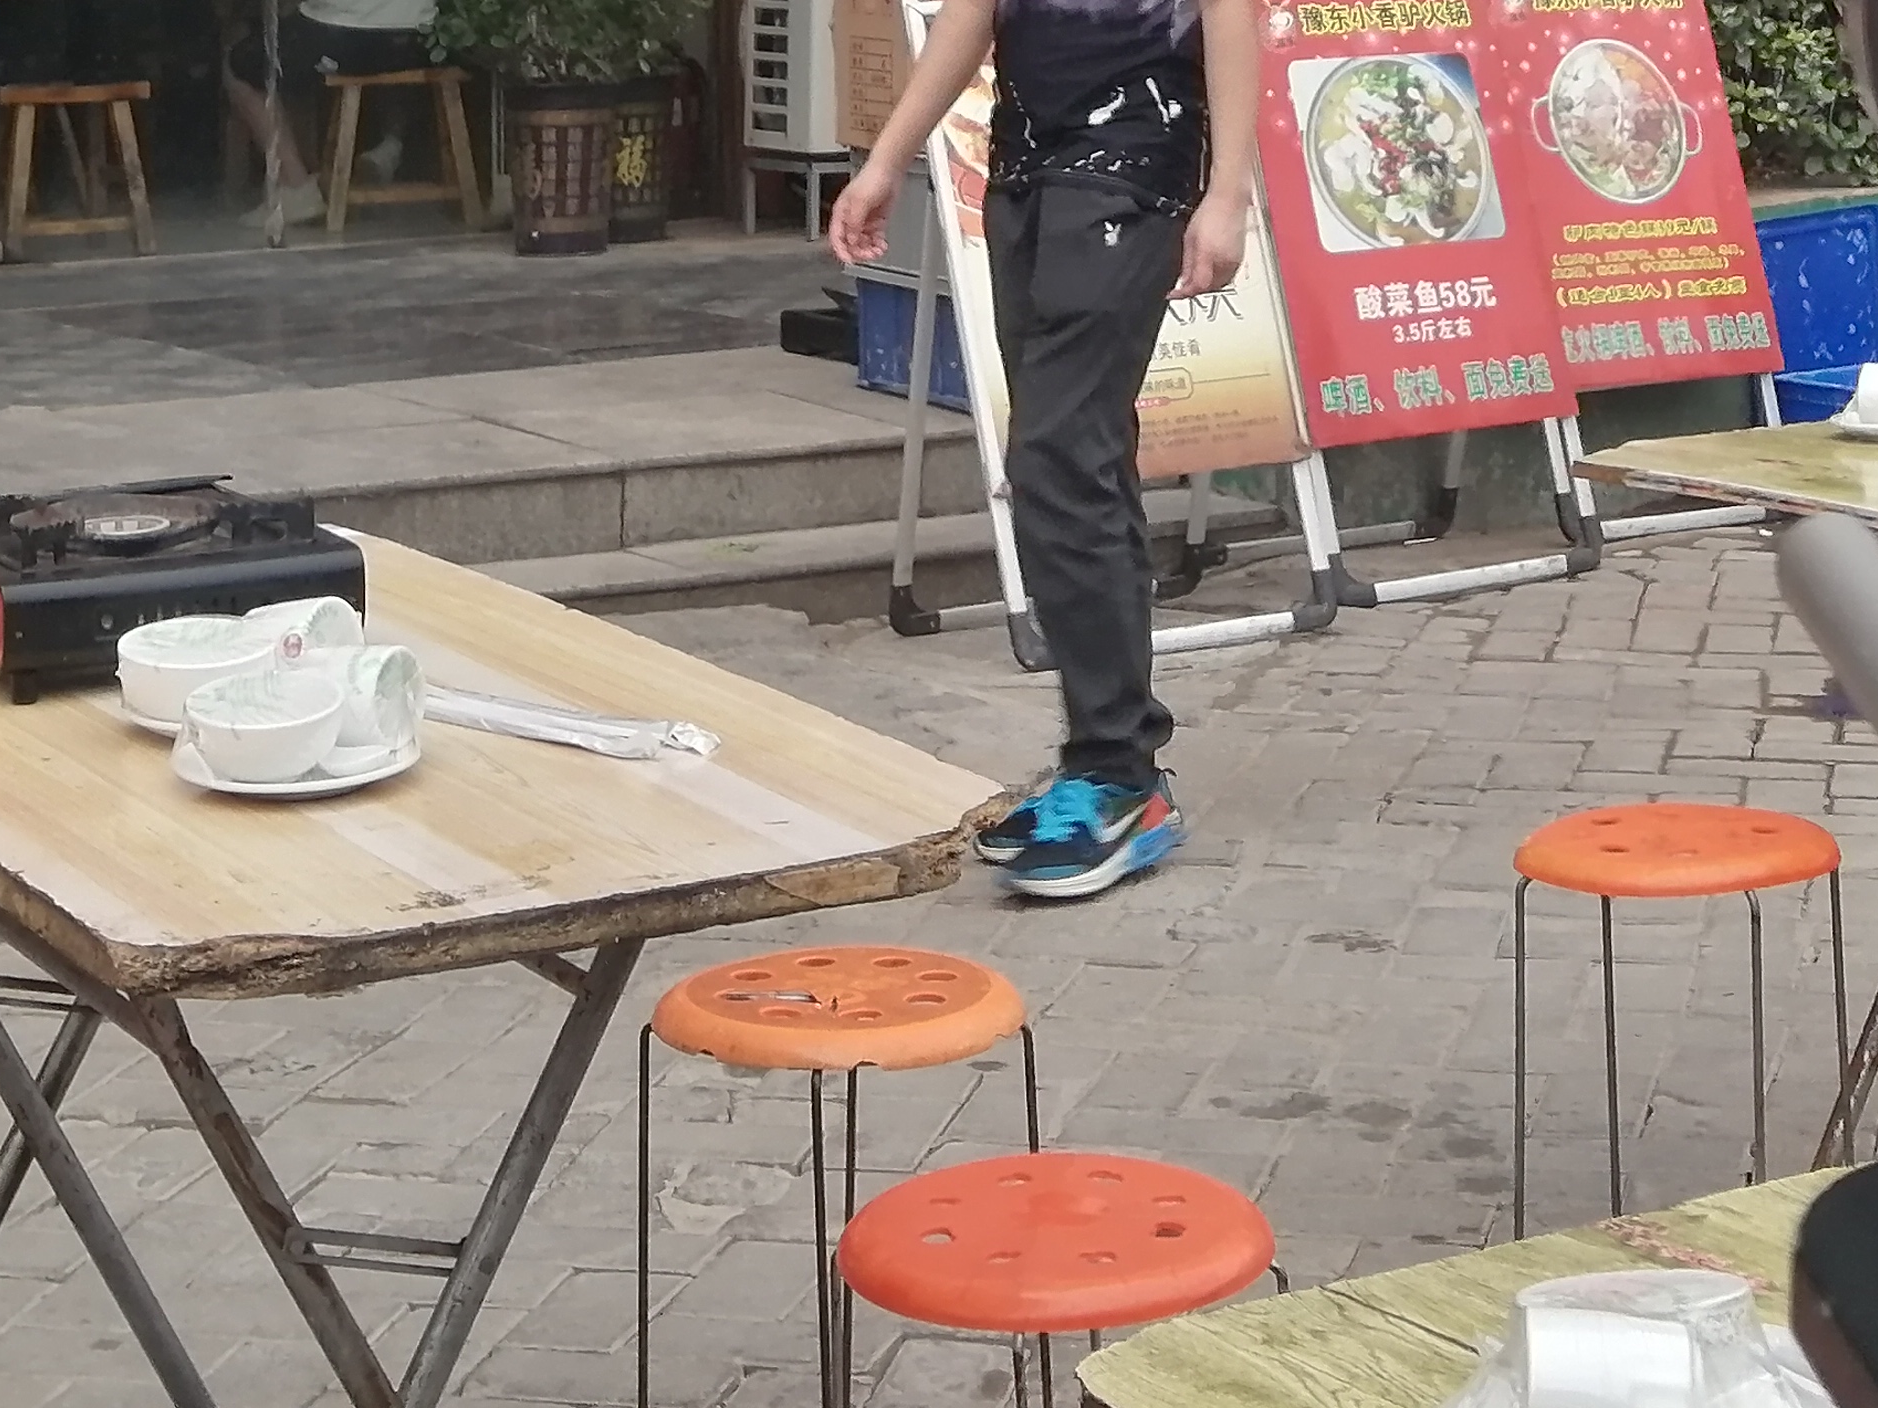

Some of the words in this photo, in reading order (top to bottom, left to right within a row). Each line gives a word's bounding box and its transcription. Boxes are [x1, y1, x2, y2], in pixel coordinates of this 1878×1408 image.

[1353, 275, 1498, 320] 酸菜鱼58元
[1391, 316, 1473, 343] 3.5斤左右
